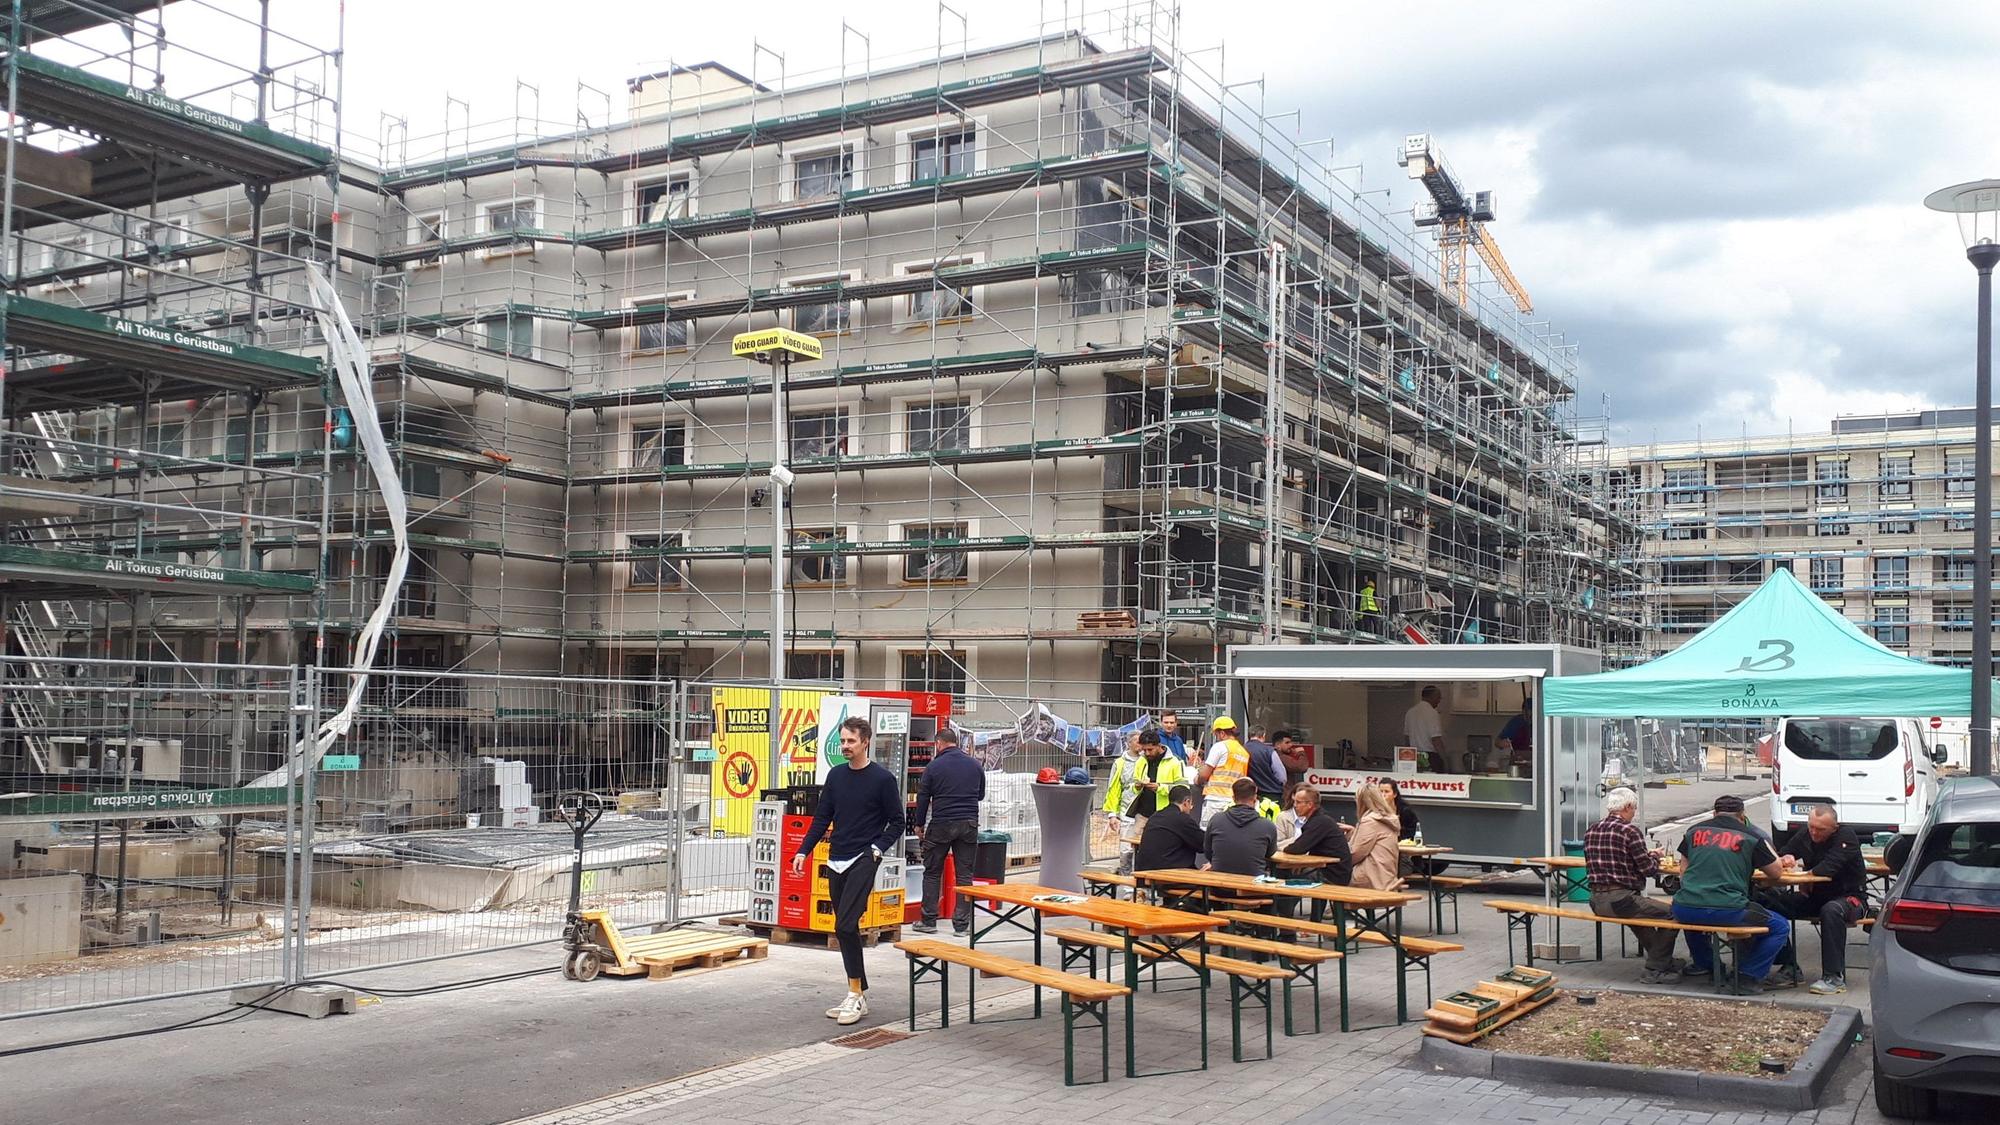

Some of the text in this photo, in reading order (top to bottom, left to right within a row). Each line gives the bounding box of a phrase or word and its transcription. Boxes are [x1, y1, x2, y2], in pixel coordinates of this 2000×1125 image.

[126, 87, 242, 132] Ali Tokus Gerüstbau
[115, 320, 233, 354] Ali Tokus Gerüstbau
[757, 336, 778, 347] GUARD
[802, 343, 820, 354] GUARD
[105, 560, 224, 580] Ali Tokus Gerüstbau
[1722, 698, 1779, 708] BONAVA
[728, 710, 768, 724] VIDEO
[1308, 774, 1352, 788] Curry
[160, 793, 196, 804] Tokus
[198, 792, 214, 803] Ali
